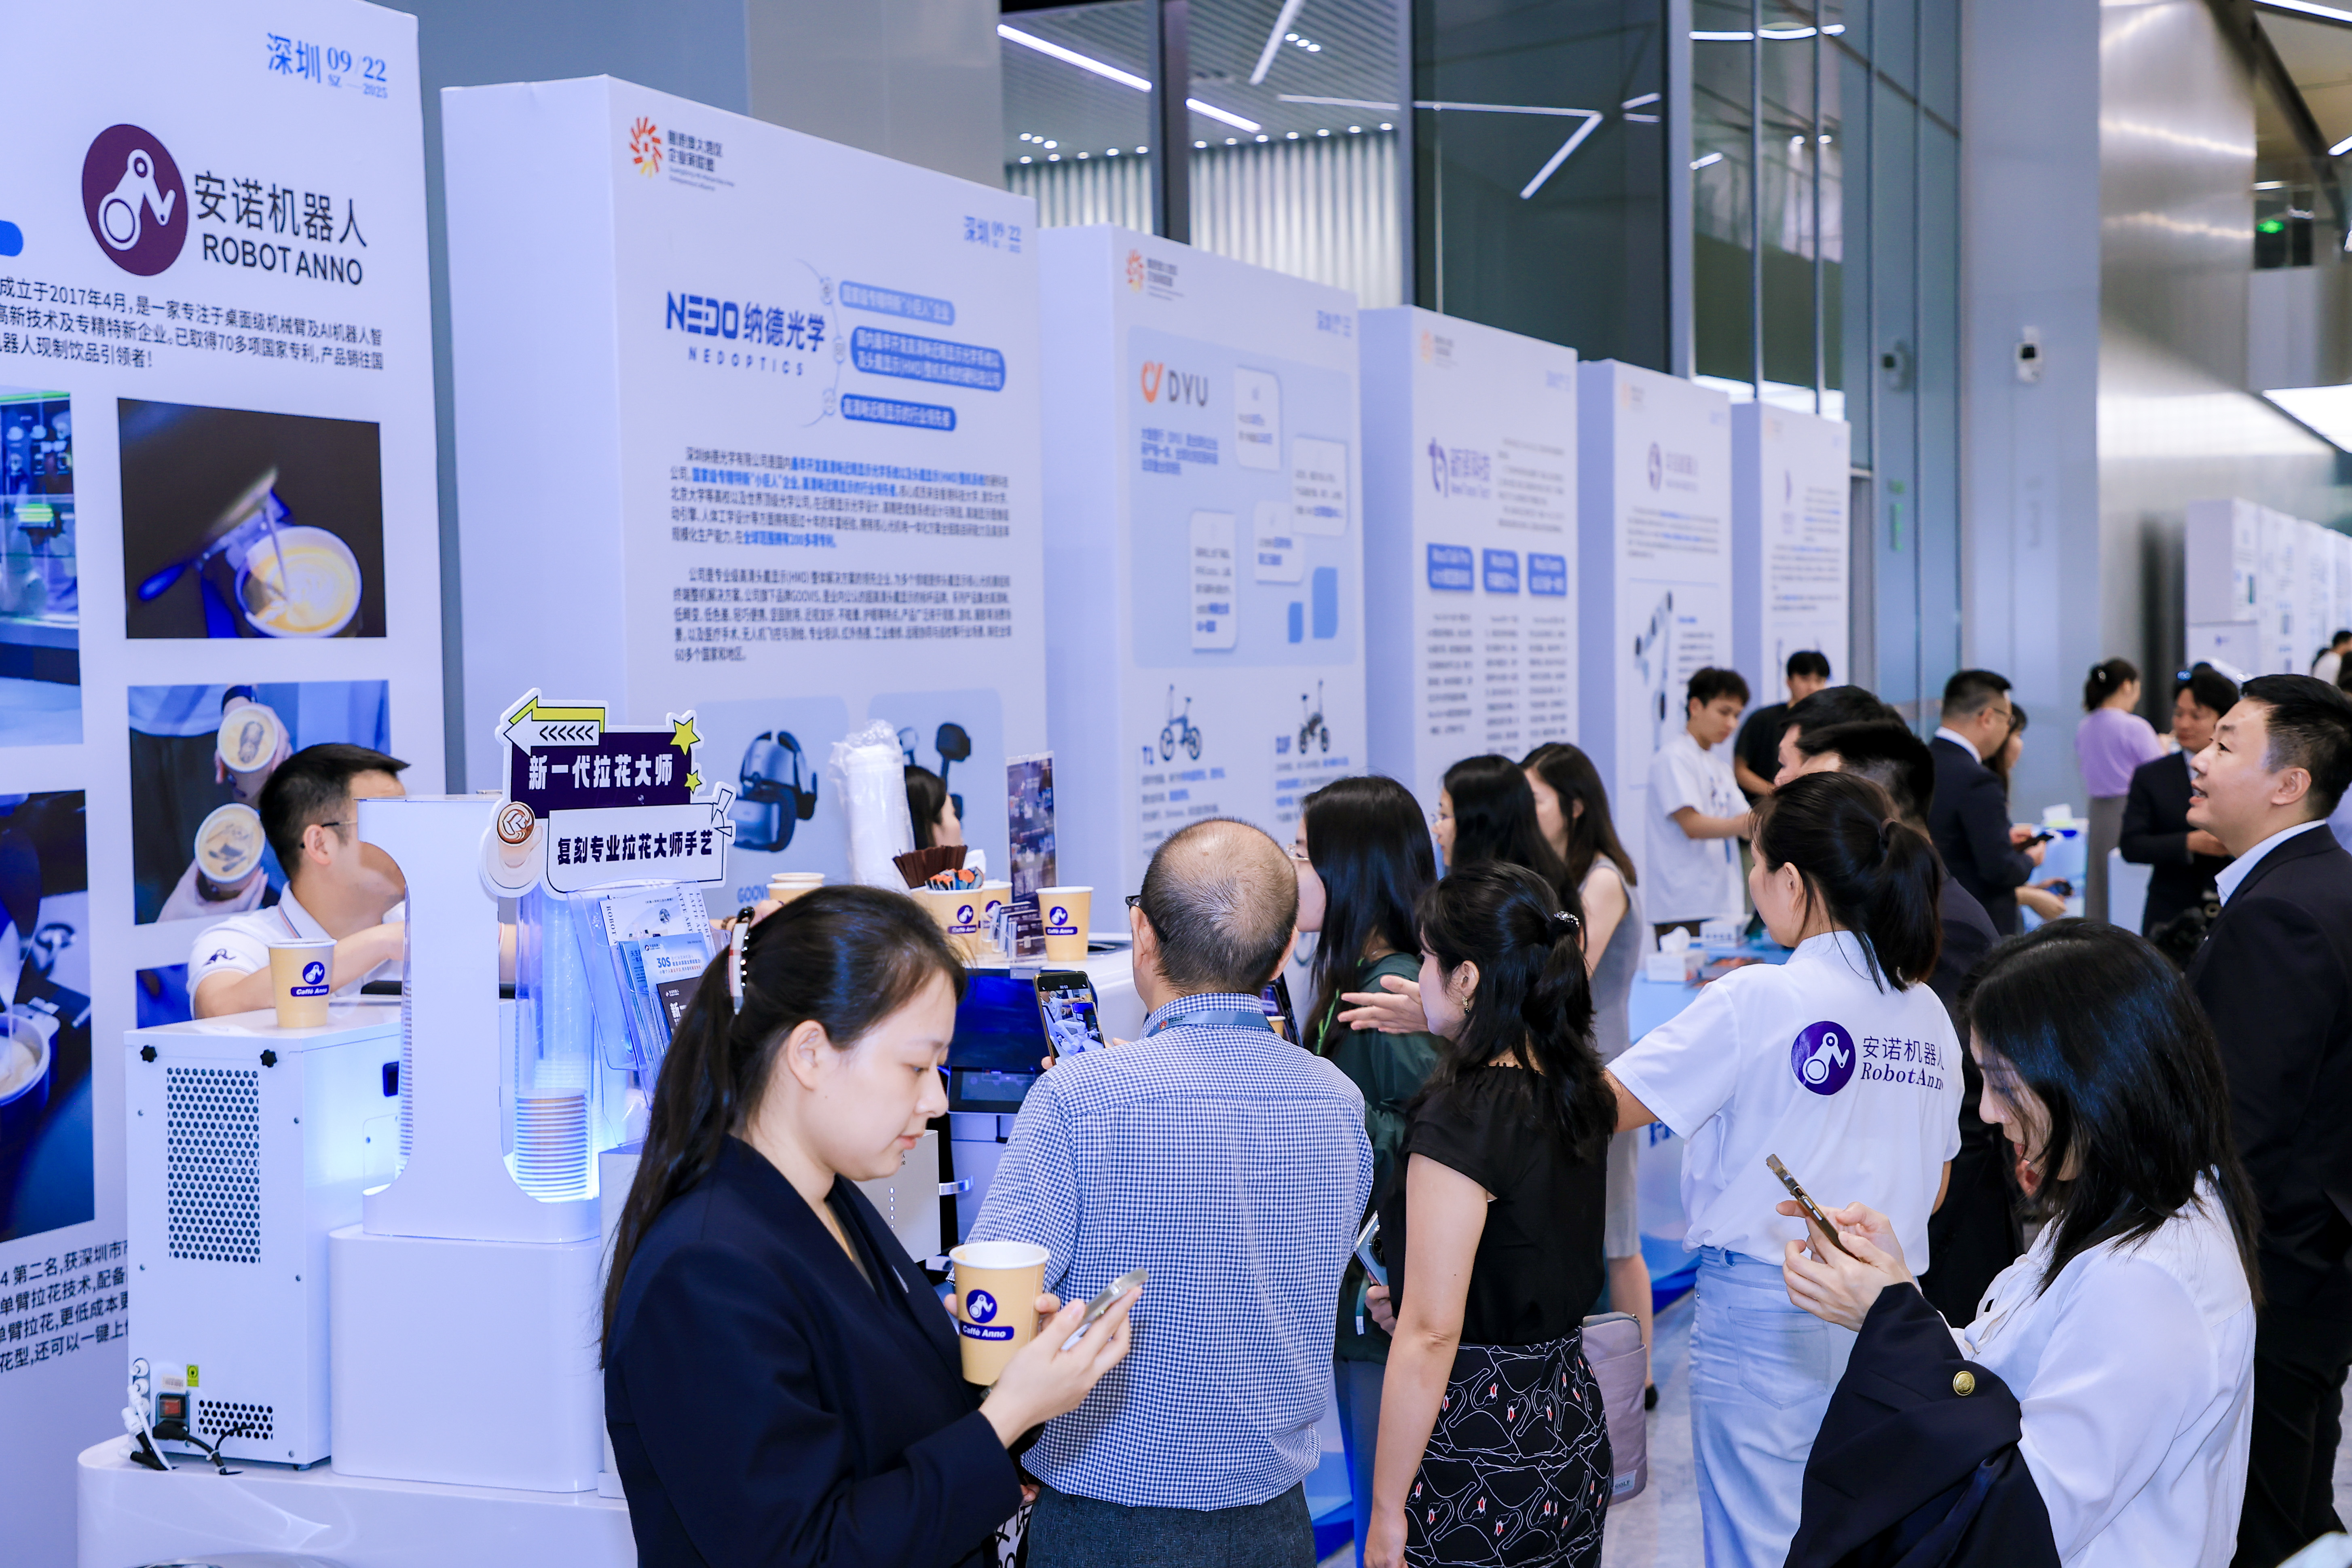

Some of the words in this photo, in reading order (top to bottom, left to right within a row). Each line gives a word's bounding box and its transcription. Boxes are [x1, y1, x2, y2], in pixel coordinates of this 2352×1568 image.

[267, 32, 321, 84] 深圳
[194, 170, 368, 248] 安诺机器人
[964, 216, 989, 246] 深圳
[743, 301, 825, 352] 纳德光学
[689, 347, 803, 376] NEDOPTICS
[1168, 370, 1209, 406] DYU
[529, 754, 674, 790] 新一代拉花大师
[557, 829, 713, 865] 复刻专业拉花大师手艺
[606, 906, 617, 936] ROBOT
[676, 887, 687, 913] LATTE
[685, 917, 693, 933] ART
[689, 893, 699, 920] LATTE
[696, 893, 706, 919] LATTE
[657, 957, 671, 968] 30S
[1863, 1035, 1944, 1070] 安诺机器人
[1860, 1062, 1944, 1090] RobotAnn
[982, 1329, 1006, 1338] Anno
